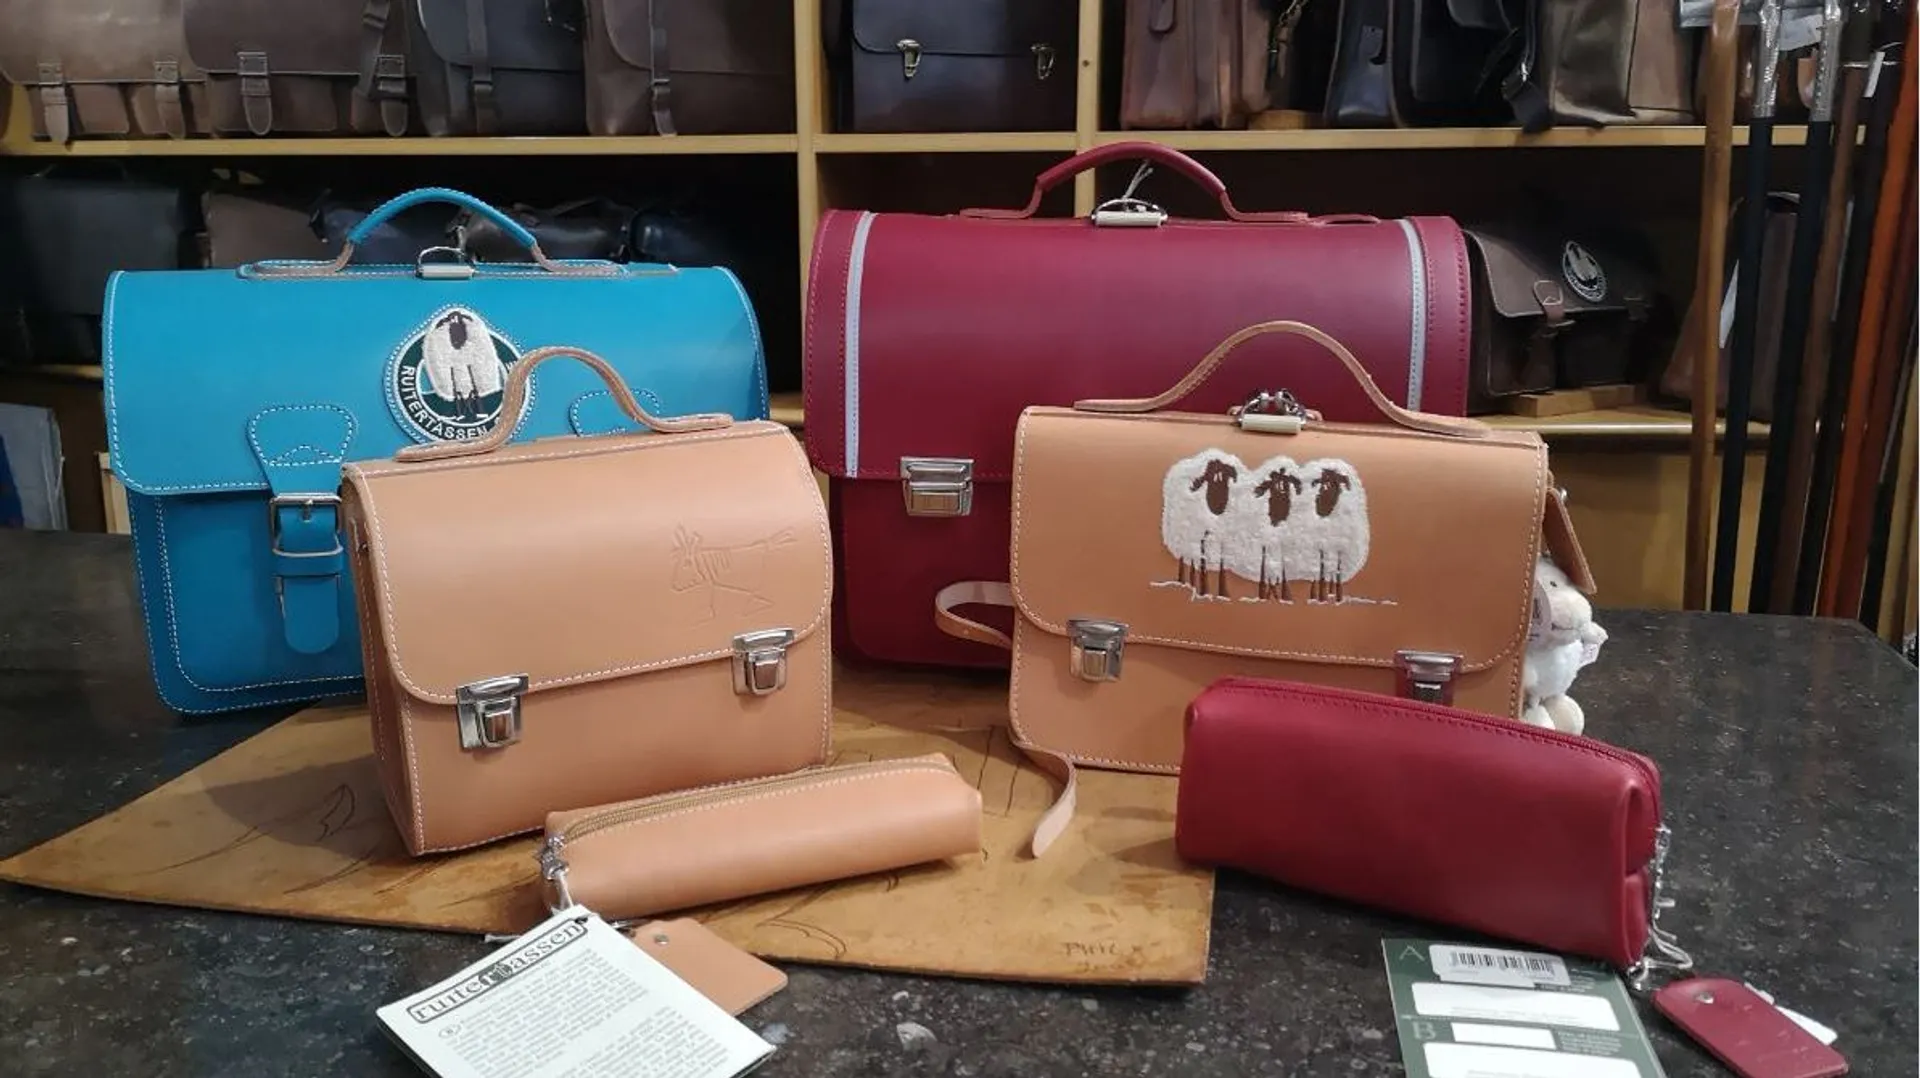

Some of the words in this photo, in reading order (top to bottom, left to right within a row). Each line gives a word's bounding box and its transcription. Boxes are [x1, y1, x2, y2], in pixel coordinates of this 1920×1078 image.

[401, 365, 488, 440] RUITERTASSEN
[413, 922, 582, 1020] ruitertassen
[1400, 945, 1425, 961] A
[1411, 1021, 1436, 1040] B
